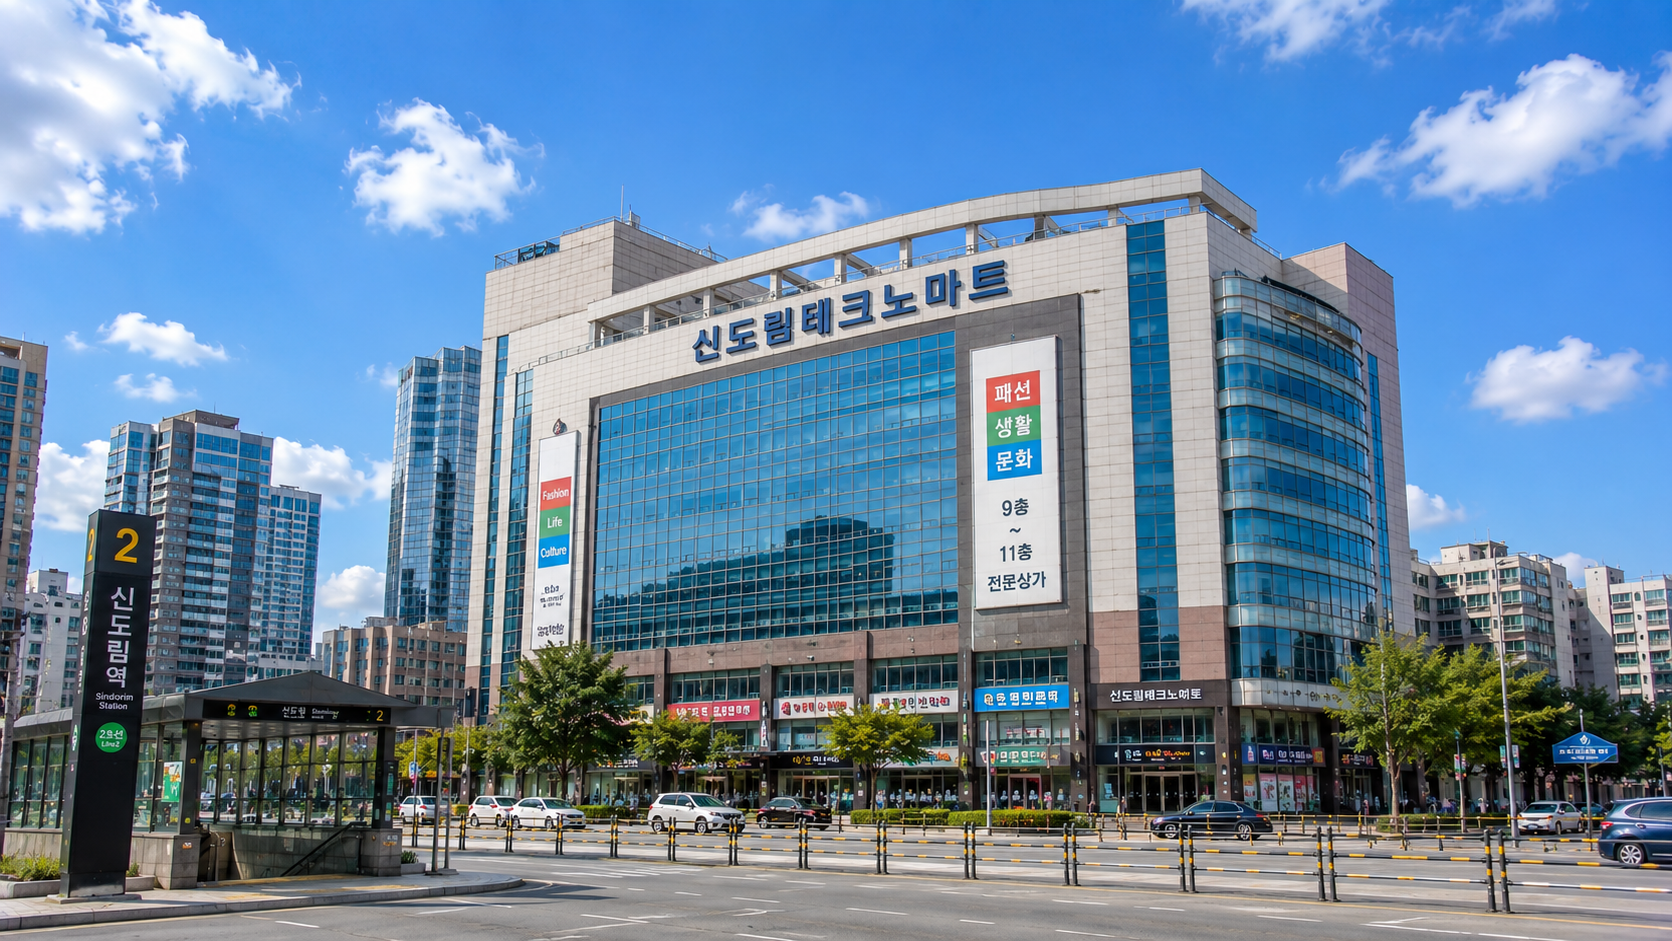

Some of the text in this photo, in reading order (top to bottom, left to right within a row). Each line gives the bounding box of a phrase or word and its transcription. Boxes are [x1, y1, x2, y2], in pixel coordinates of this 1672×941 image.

[691, 259, 1009, 363] 신도림테크노마트
[994, 379, 1031, 403] 패션
[995, 413, 1032, 438] 생활
[995, 448, 1033, 472] 문화
[542, 488, 569, 501] Fashion
[1002, 498, 1029, 516] 9층
[547, 516, 563, 529] Life
[87, 528, 95, 562] 2
[114, 527, 139, 564] 2
[999, 543, 1032, 562] 11층
[987, 571, 1046, 593] 전문상가
[106, 586, 135, 688] 신도림역
[95, 691, 134, 701] Sindorim
[99, 701, 128, 710] Station
[376, 710, 384, 721] 2
